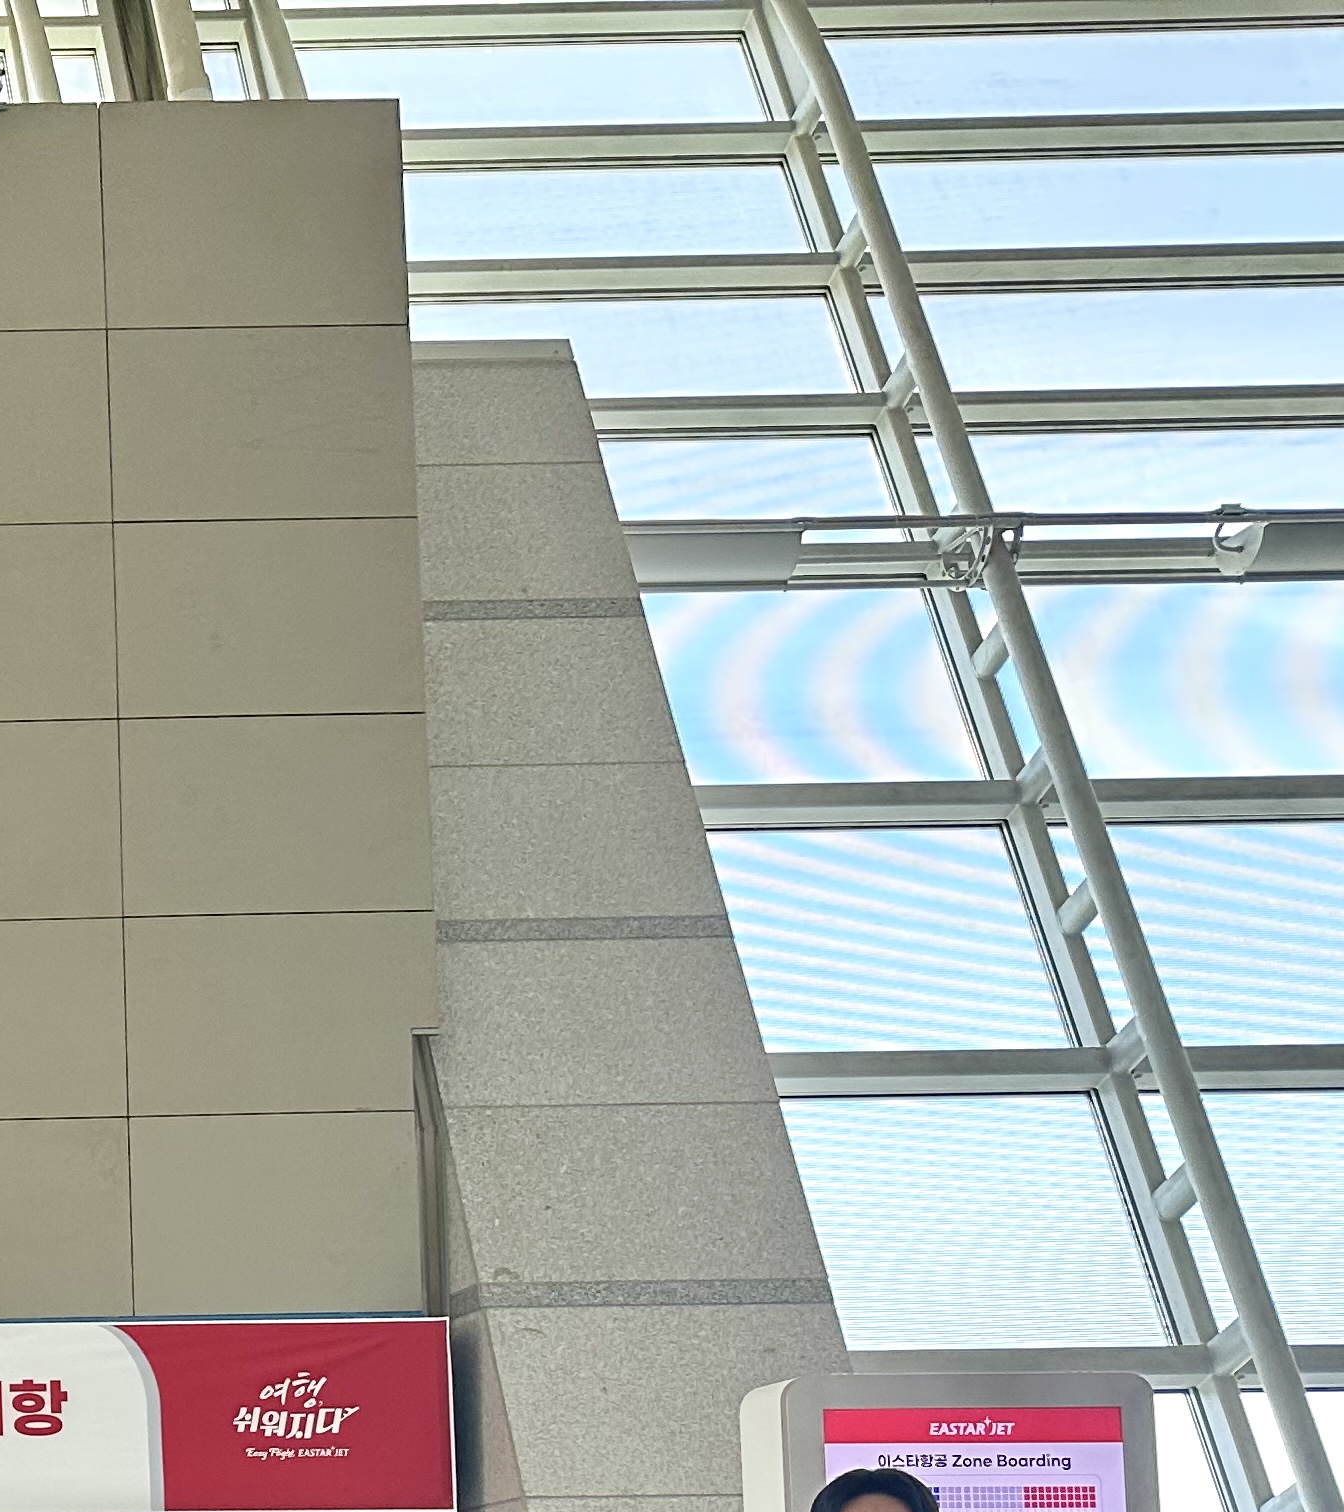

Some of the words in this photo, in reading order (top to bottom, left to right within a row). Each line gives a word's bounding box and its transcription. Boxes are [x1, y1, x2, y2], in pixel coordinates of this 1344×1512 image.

[232, 1406, 360, 1439] 쉬워지다
[877, 1454, 948, 1468] 이스타항공
[952, 1454, 993, 1468] Zone
[997, 1454, 1072, 1470] Boarding
